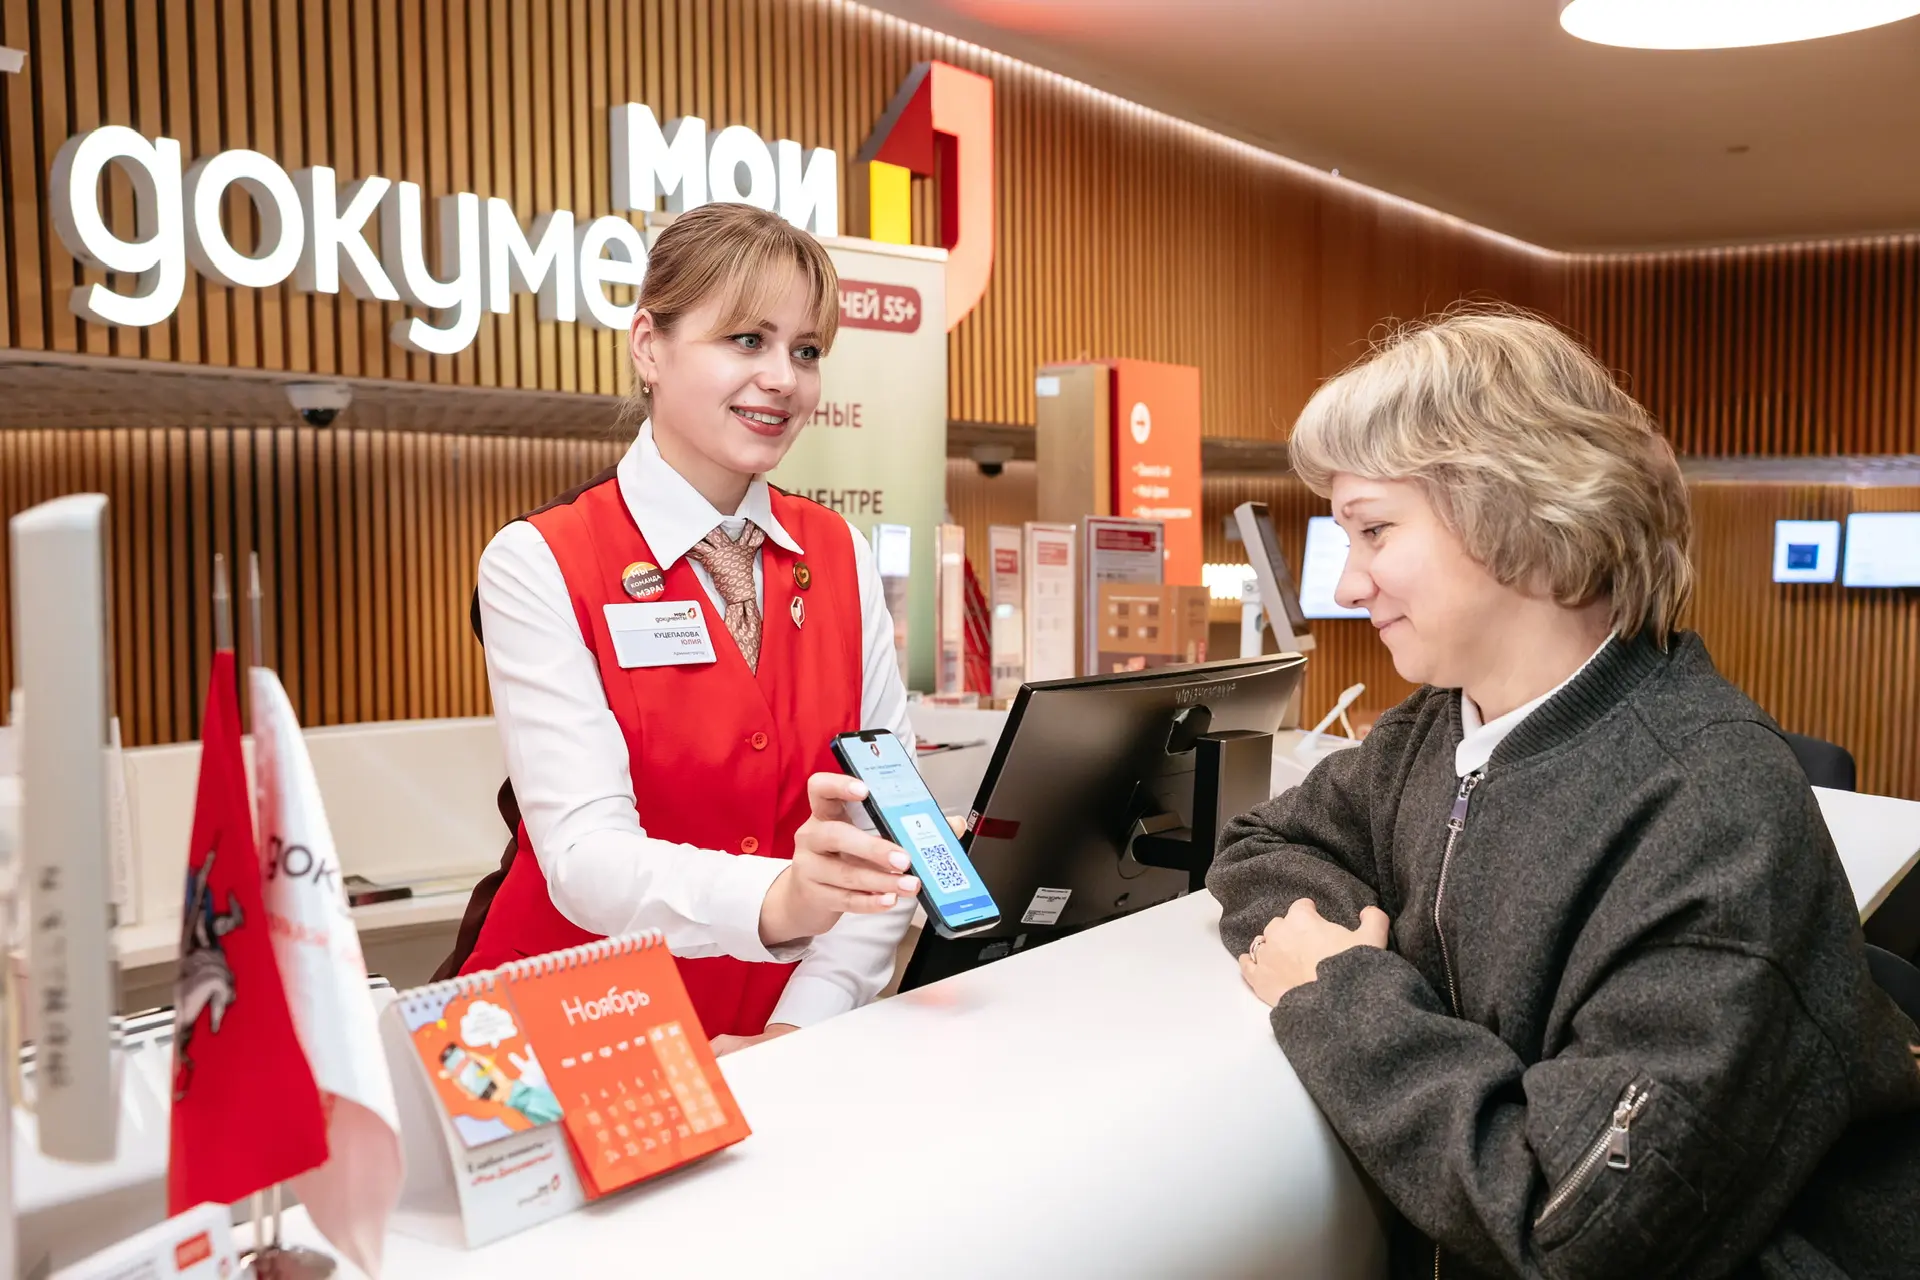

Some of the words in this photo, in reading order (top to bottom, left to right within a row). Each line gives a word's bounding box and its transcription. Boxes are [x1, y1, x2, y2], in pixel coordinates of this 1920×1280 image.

[626, 101, 838, 237] мои
[882, 295, 917, 323] 55+
[806, 402, 863, 428] НЫЕ
[796, 489, 884, 514] ЕНТРЕ
[630, 574, 661, 589] КОМАНДА
[636, 583, 665, 599] МЭРА!
[653, 631, 700, 639] КУЦЕПАЛОВА
[680, 638, 702, 646] ЮЛИЯ
[560, 985, 651, 1028] Ноябрь
